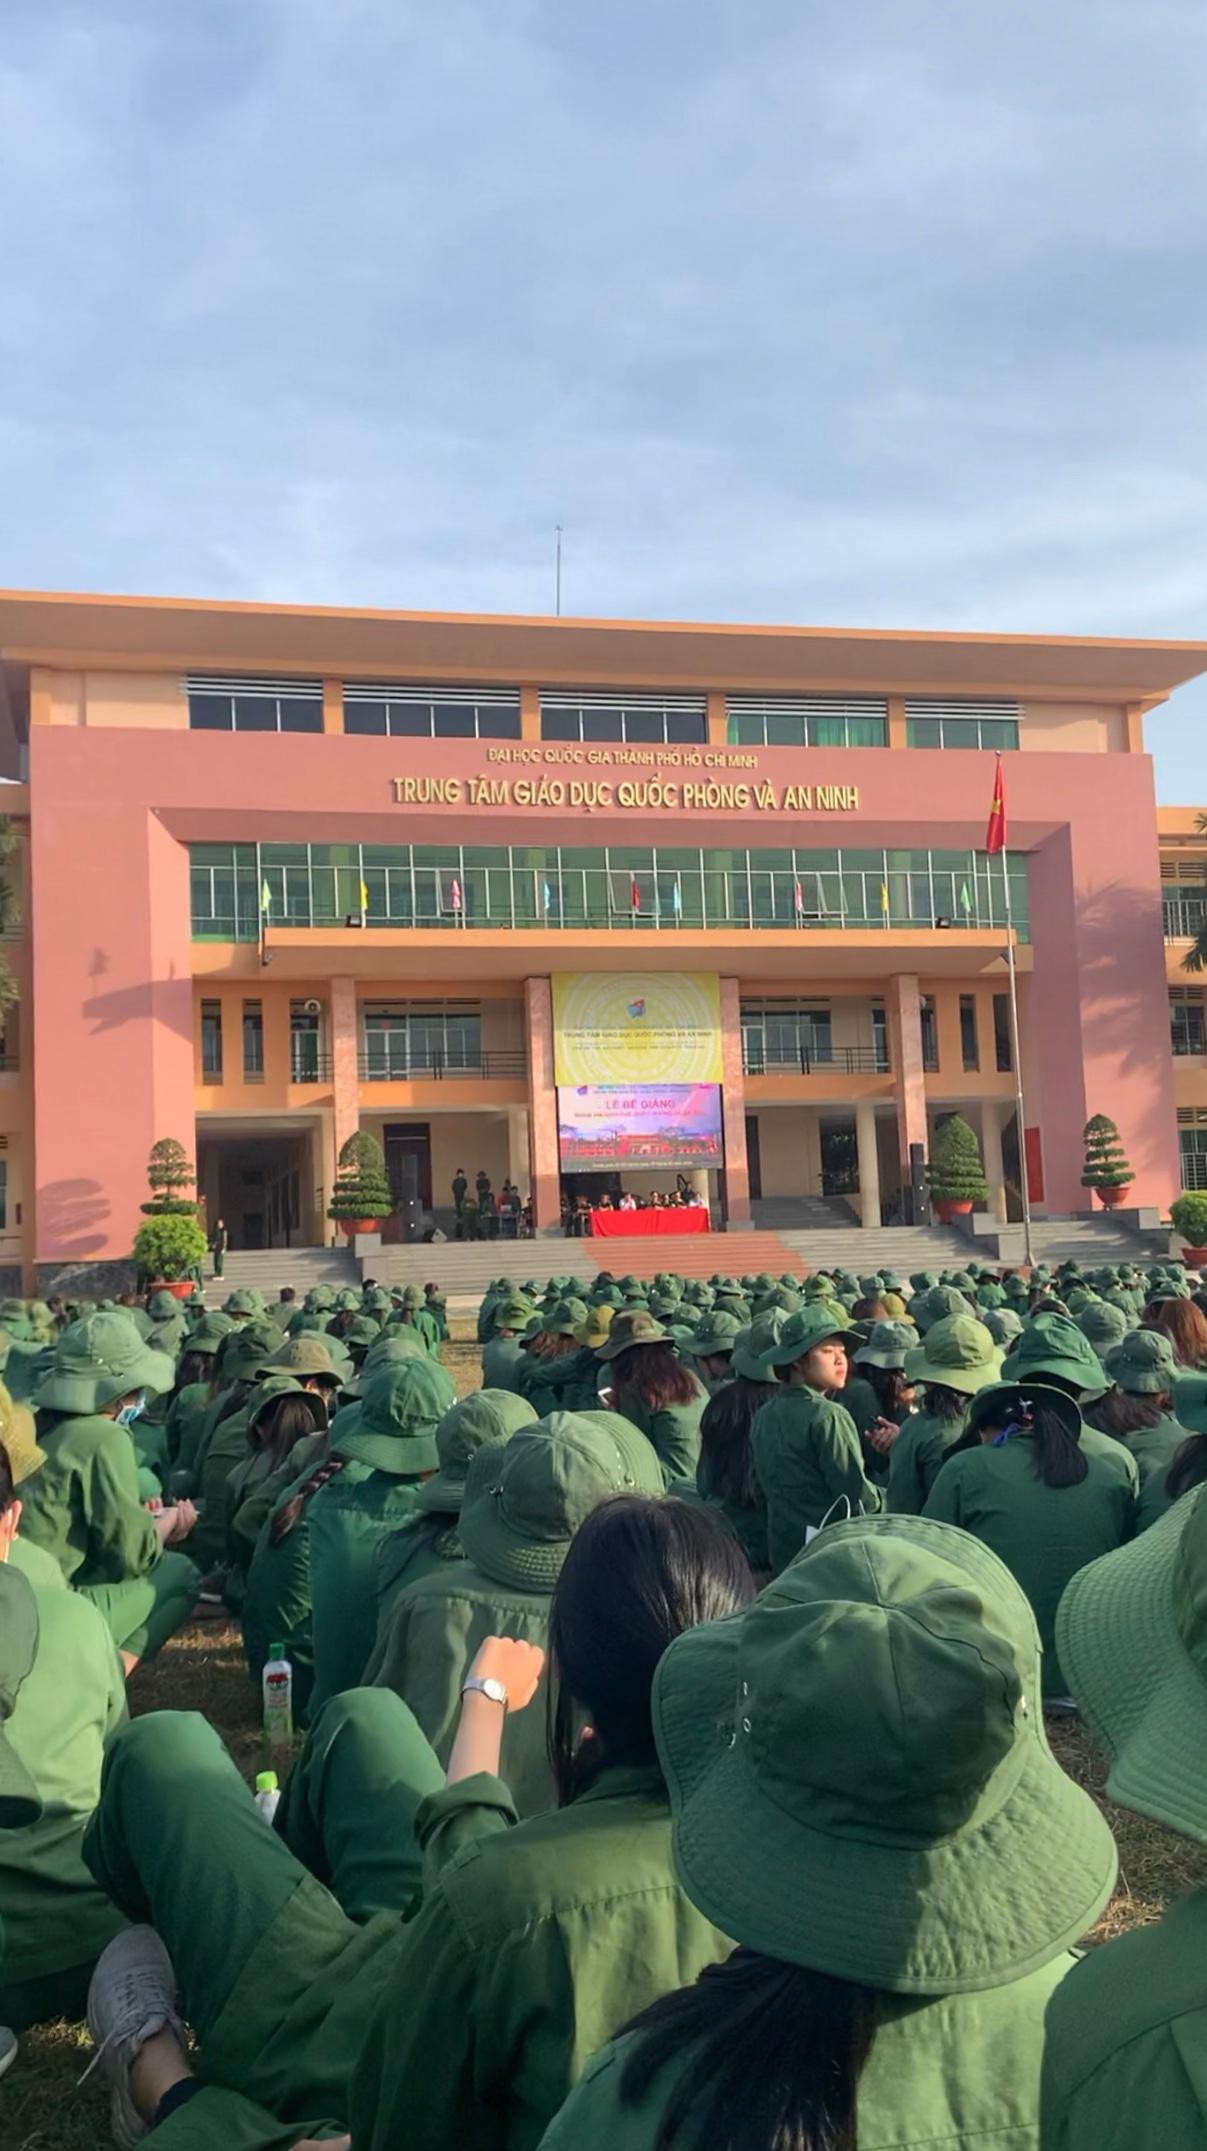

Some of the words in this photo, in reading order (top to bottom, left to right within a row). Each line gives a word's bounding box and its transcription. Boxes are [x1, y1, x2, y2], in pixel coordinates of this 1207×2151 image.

[488, 748, 510, 765] ĐẠI
[513, 749, 541, 765] HỌC
[587, 750, 610, 764] GIA
[613, 748, 654, 765] THÀNH
[728, 754, 758, 768] MINH
[392, 777, 461, 804] TRUNG
[466, 774, 509, 805] TÂM
[513, 774, 564, 806] GIÁO
[569, 781, 612, 813] DỤC
[618, 772, 677, 808] QUỐC
[682, 777, 750, 809] PHÒNG
[752, 778, 777, 810] VÀ
[784, 785, 811, 810] AN
[816, 786, 859, 811] NINH
